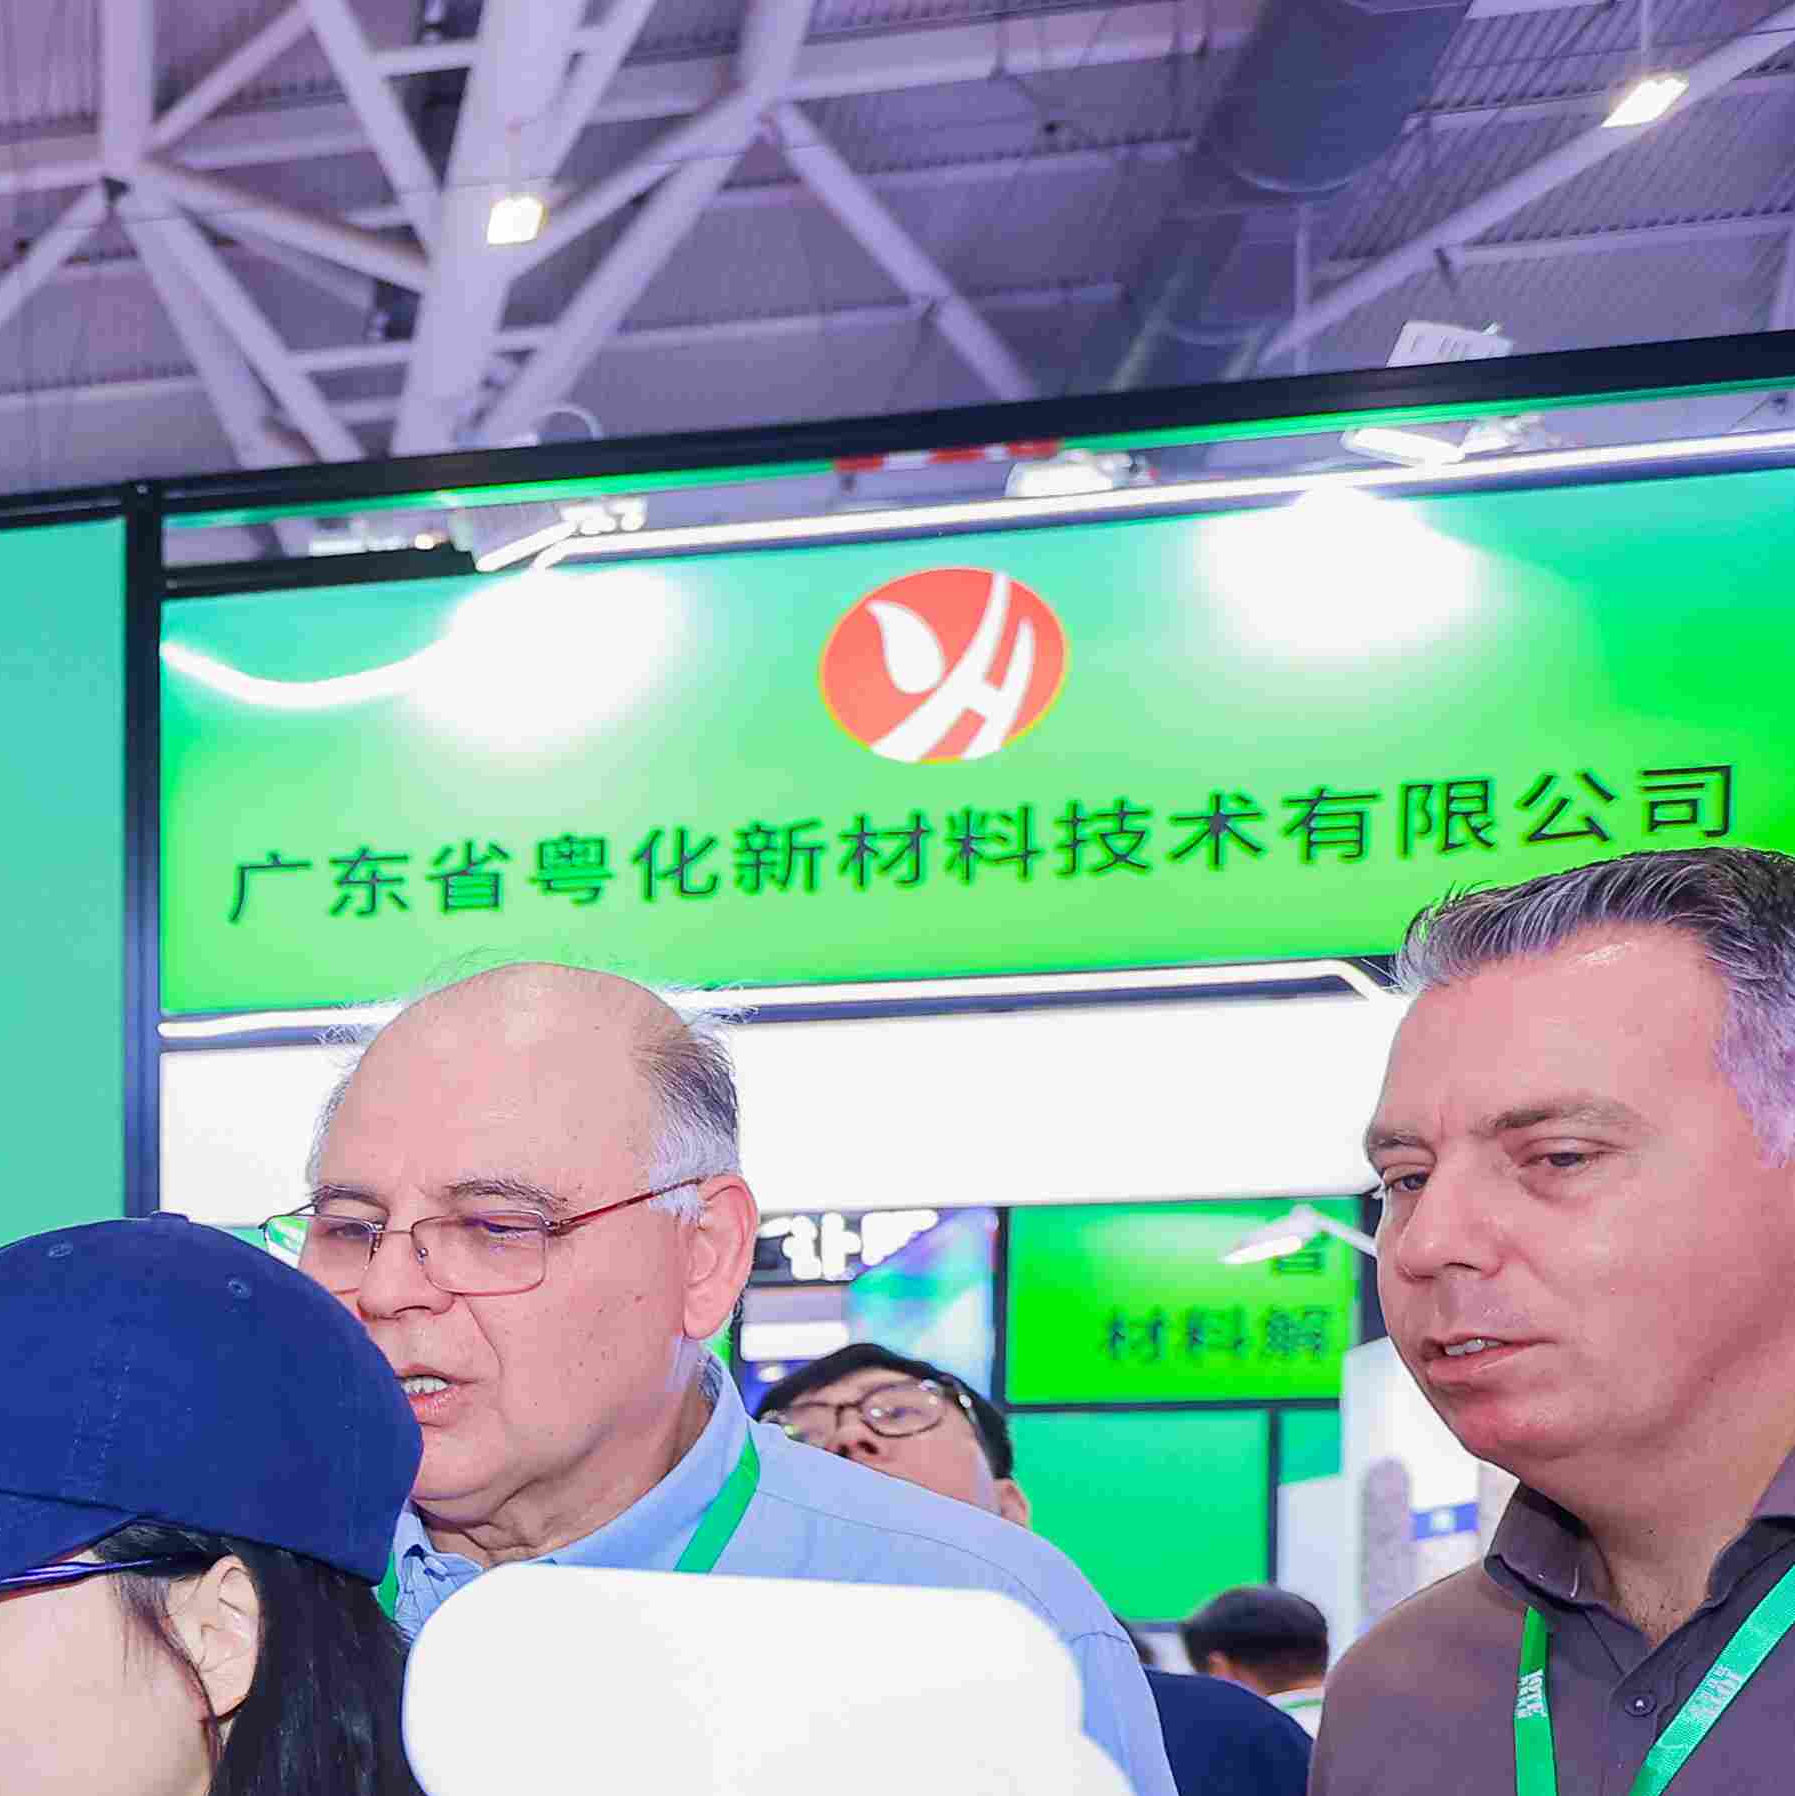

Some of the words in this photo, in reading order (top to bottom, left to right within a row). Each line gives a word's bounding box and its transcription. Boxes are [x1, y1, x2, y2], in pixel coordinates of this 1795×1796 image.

[229, 762, 1736, 926] 广东省粤化新材料技术有限公司
